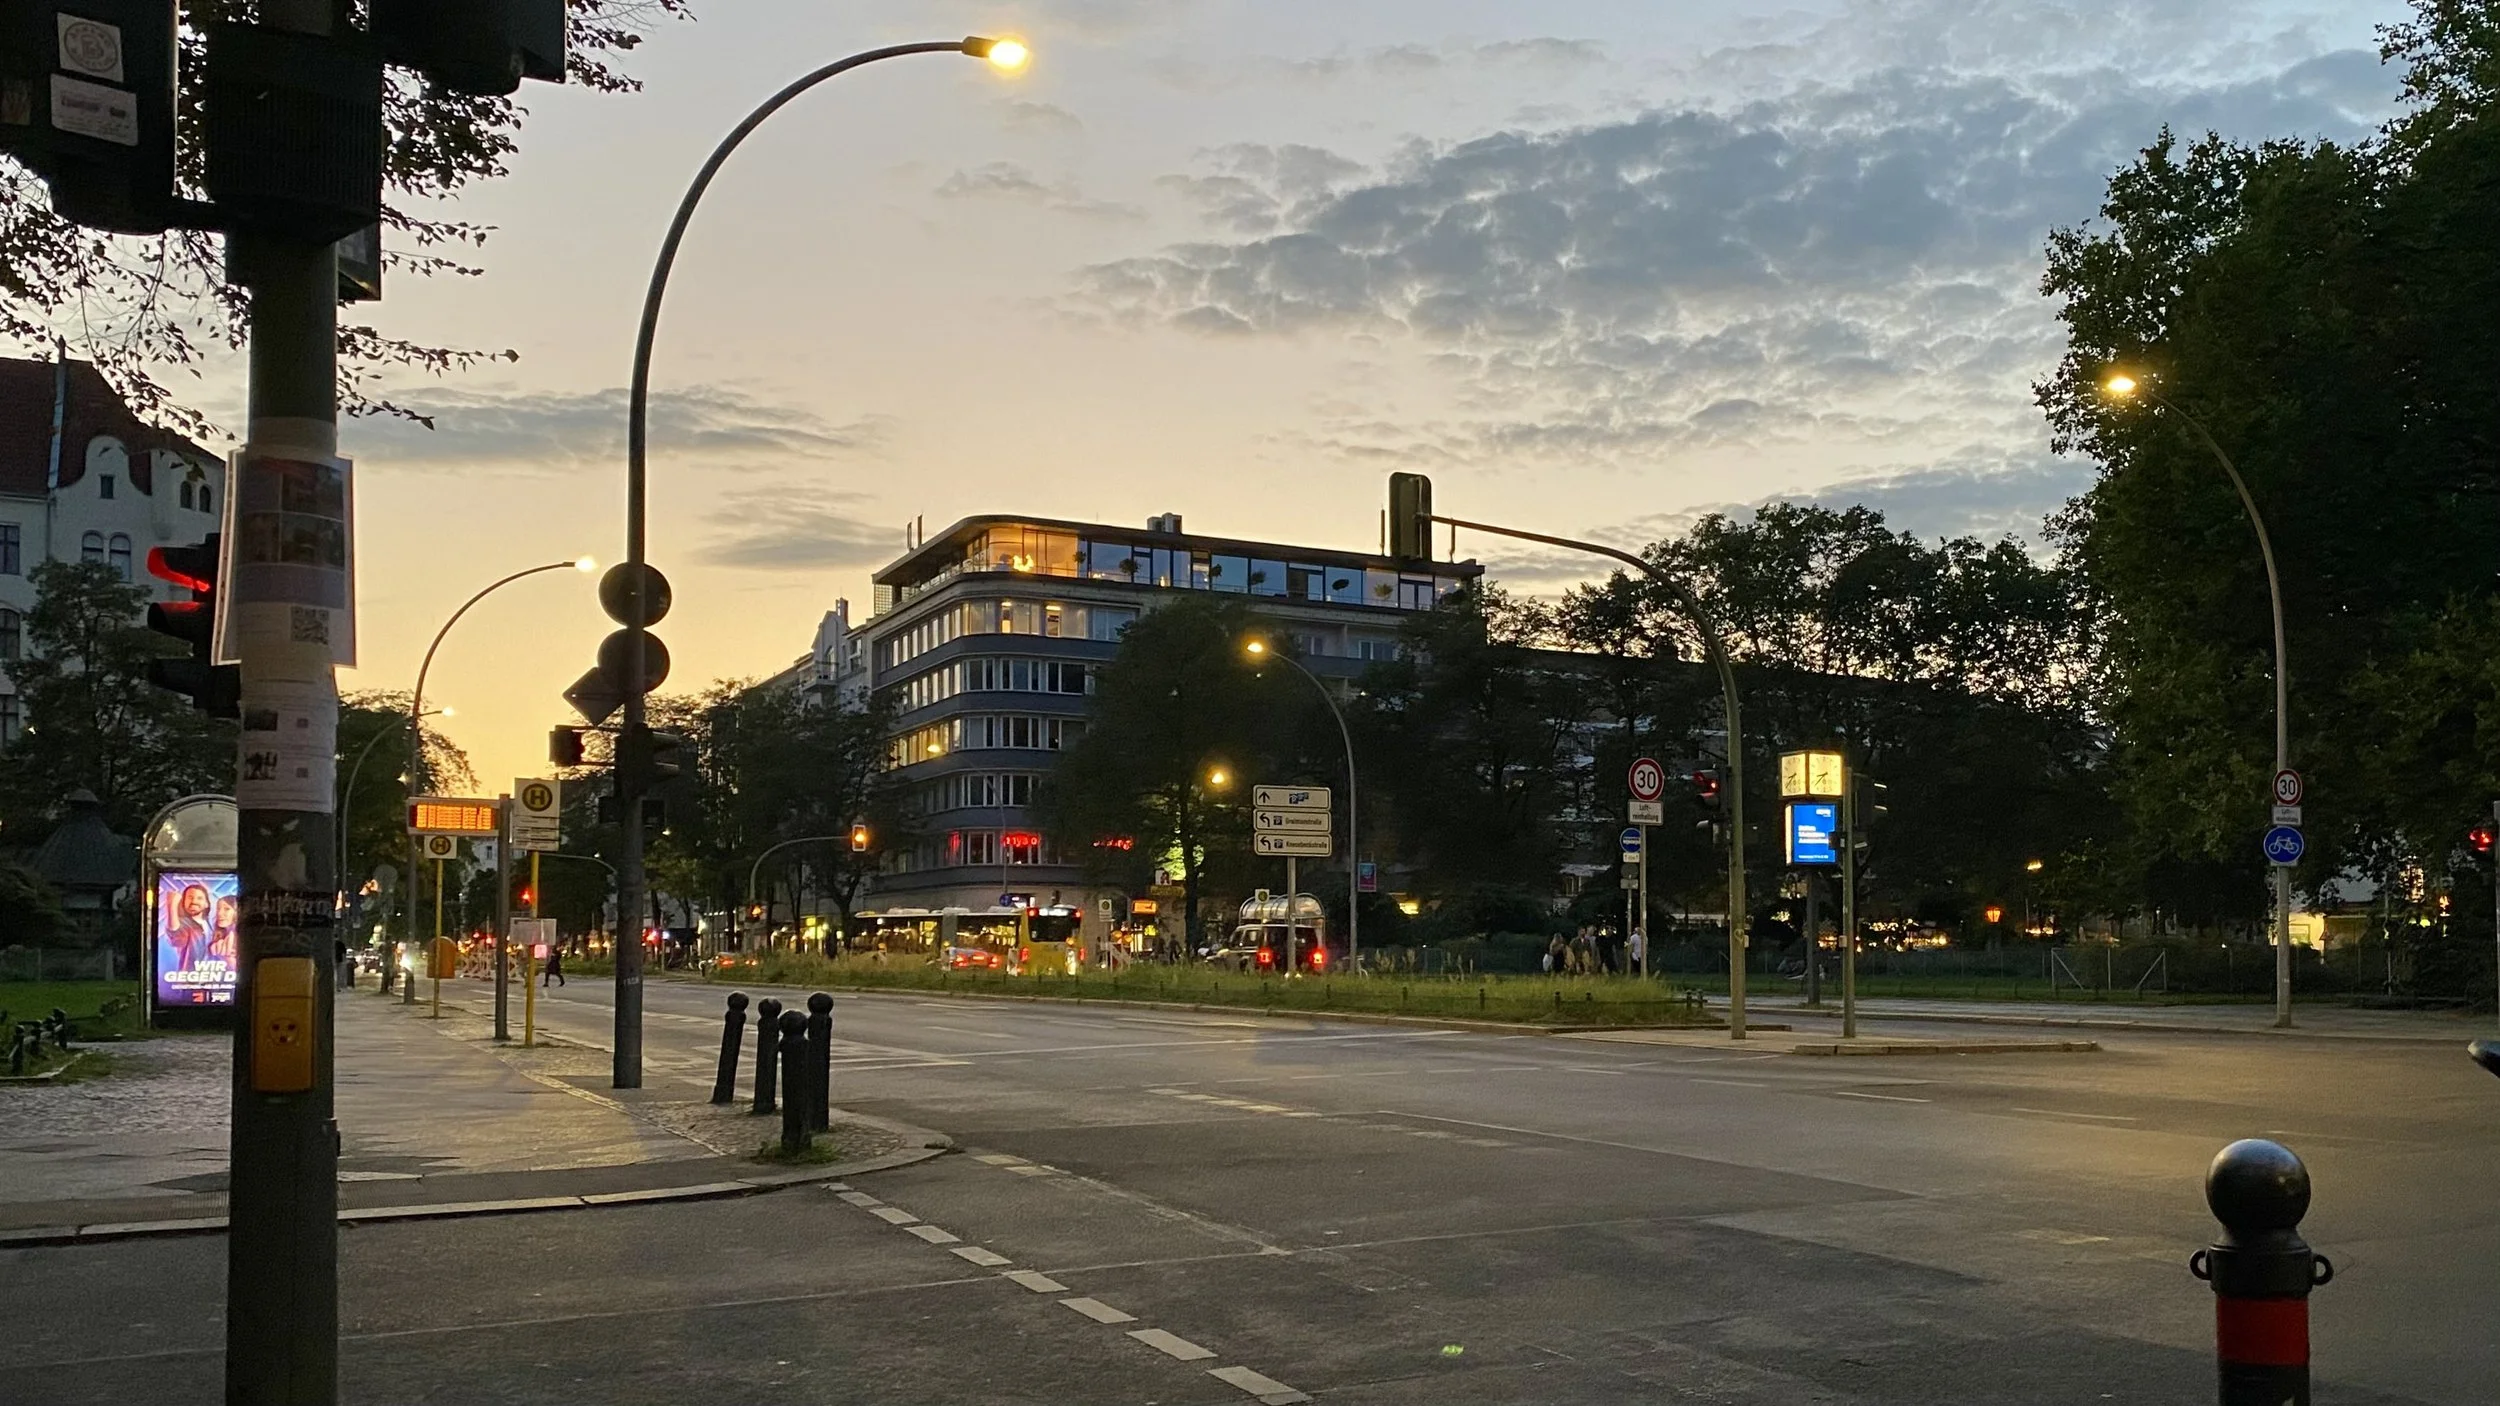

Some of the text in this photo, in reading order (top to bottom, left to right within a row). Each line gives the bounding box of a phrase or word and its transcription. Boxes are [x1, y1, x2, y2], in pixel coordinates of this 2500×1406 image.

[1637, 770, 1656, 789] 30
[2280, 780, 2296, 796] 30
[194, 960, 227, 971] WIR
[164, 971, 221, 982] GEGEN
